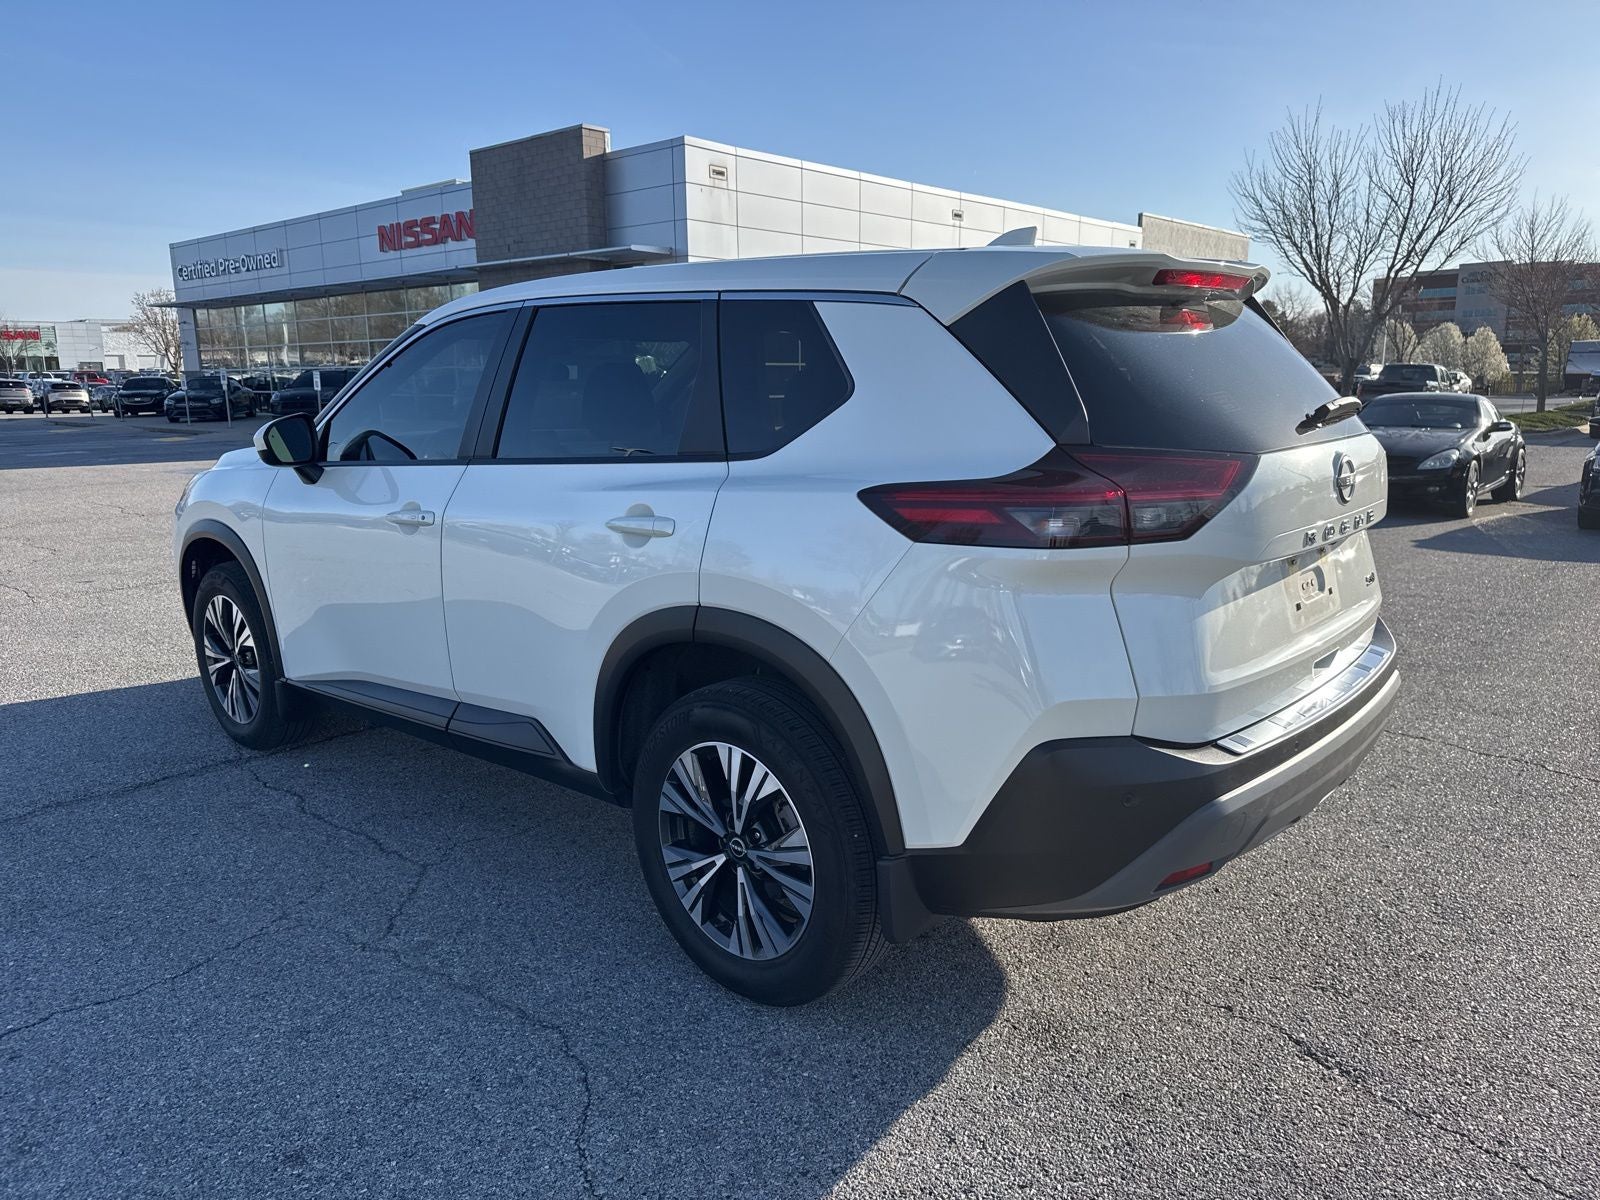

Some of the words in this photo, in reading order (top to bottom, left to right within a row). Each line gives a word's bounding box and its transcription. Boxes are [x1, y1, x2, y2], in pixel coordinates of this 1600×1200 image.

[377, 208, 476, 253] NISSAN
[177, 260, 217, 280] Certified
[218, 248, 280, 275] Pre-Owned
